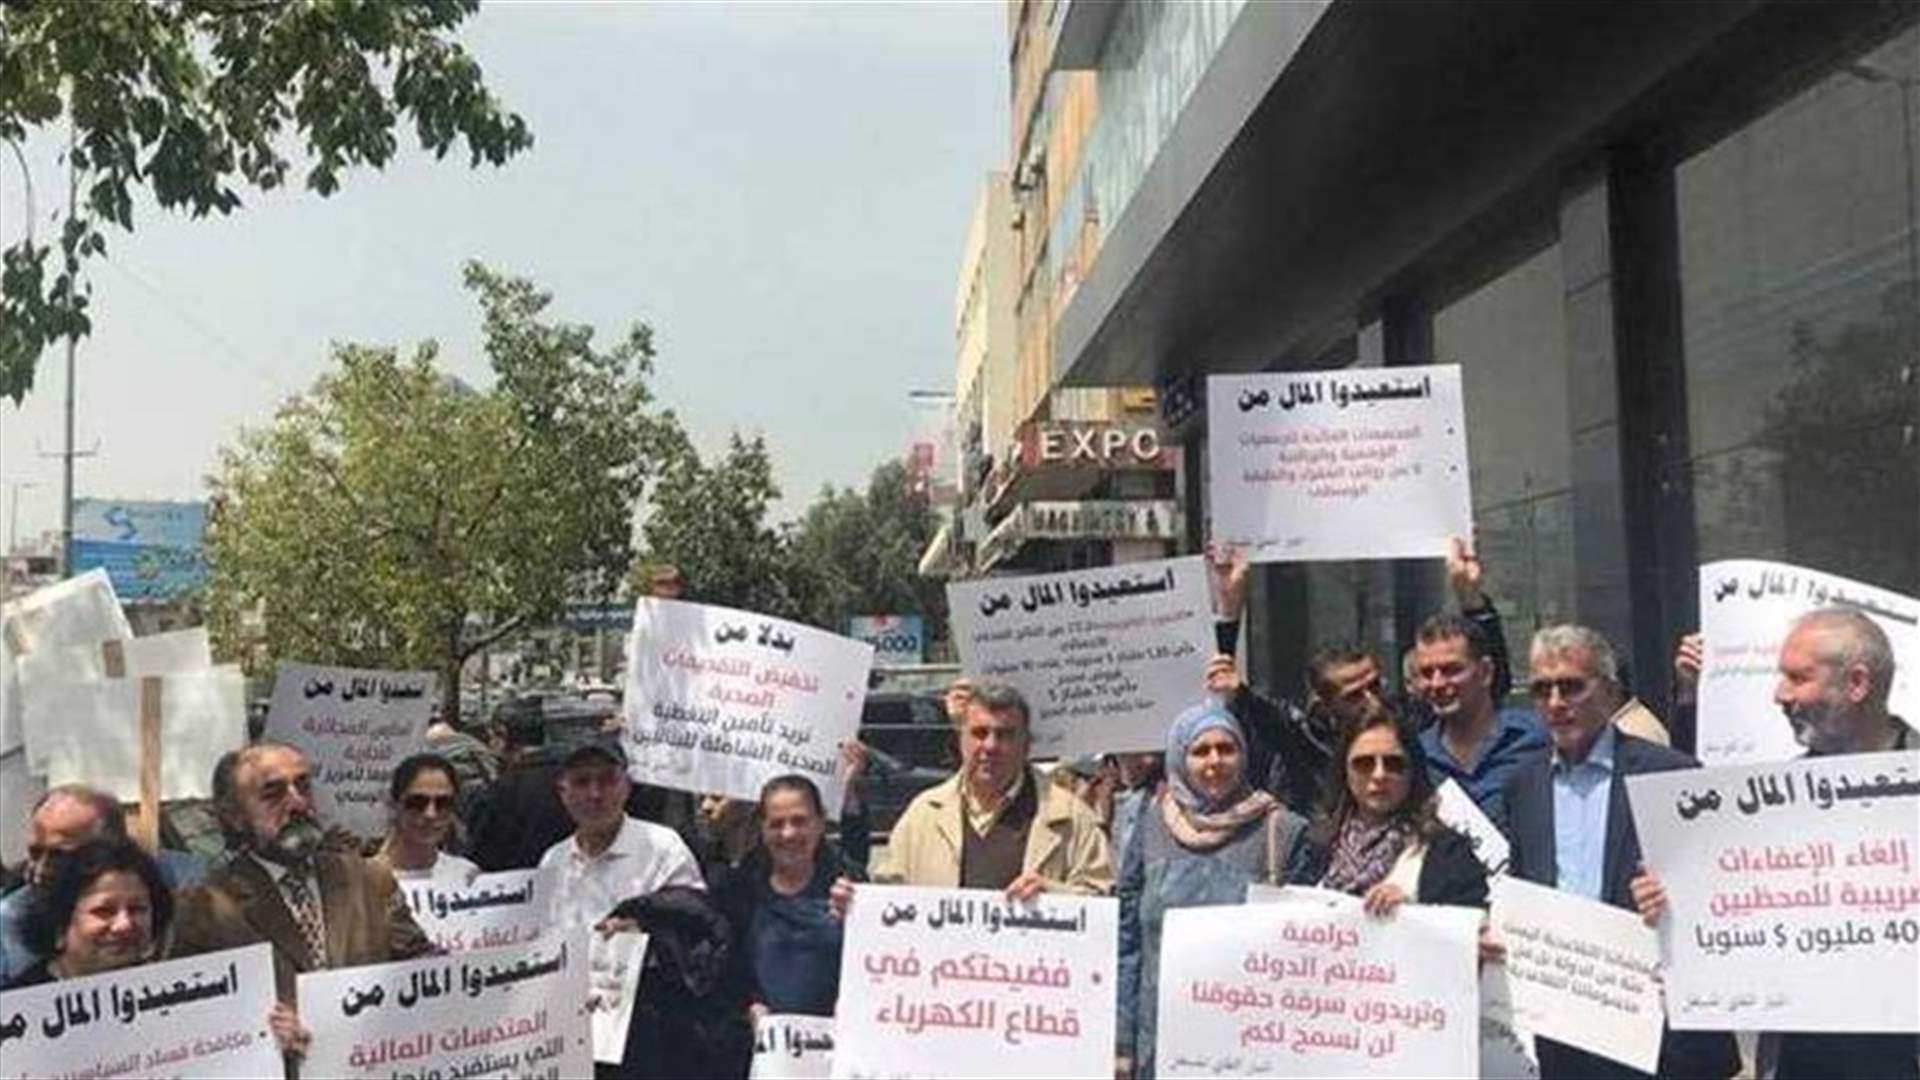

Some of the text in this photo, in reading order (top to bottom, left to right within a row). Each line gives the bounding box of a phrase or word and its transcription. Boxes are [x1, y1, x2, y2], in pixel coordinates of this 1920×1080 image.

[1238, 374, 1431, 412] استعيدوا المال من
[1040, 427, 1160, 460] EXPO
[980, 567, 1174, 617] استعيدوا المال من
[1748, 571, 1799, 599] المال
[715, 622, 794, 652] بدلا من
[304, 681, 333, 699] من
[1677, 788, 1722, 820] من
[1737, 772, 1796, 815] المال
[1717, 837, 1908, 877] إلغاء الإعفاءات
[427, 879, 534, 919] استعيدوا
[882, 899, 1086, 937] استعيدوا المال من
[1709, 881, 1830, 917] للمحظيين
[1283, 921, 1359, 951] حرامية
[1695, 922, 1766, 955] سنويا
[1795, 921, 1875, 953] مليون
[398, 967, 450, 1007] المال
[463, 942, 567, 997] استعيدوا
[865, 947, 1070, 992] فضيحتكم في
[1243, 953, 1396, 986] نهبتم الدولة
[0, 962, 238, 1043] استعيدوا المال م
[342, 983, 385, 1017] من
[1190, 980, 1446, 1030] وتريدون سرقة حقوقنا
[348, 1009, 547, 1069] الهندسات المالية
[876, 995, 1080, 1045] قطاع الكهرباء
[1241, 1021, 1395, 1058] لن نسمح لكم
